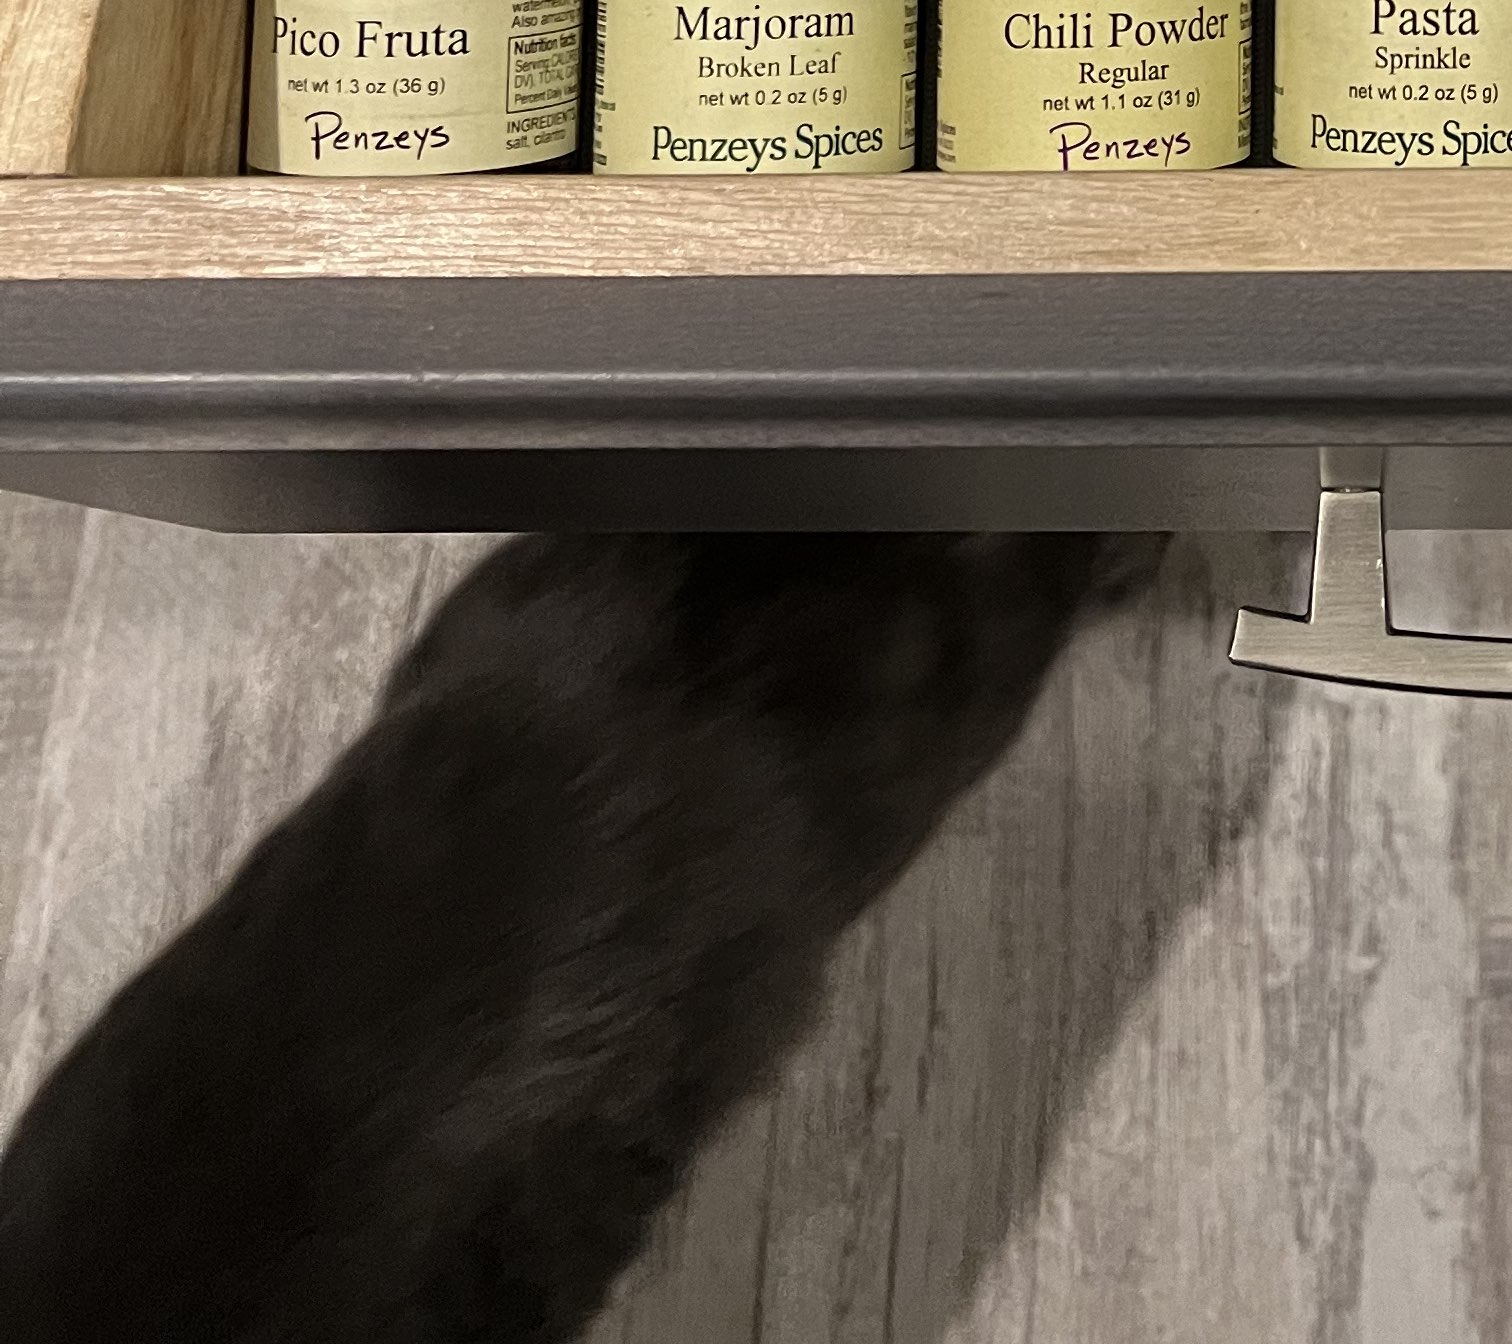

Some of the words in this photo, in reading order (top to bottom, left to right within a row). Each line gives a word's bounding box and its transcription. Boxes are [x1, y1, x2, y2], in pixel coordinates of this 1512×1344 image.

[272, 16, 340, 56] Pico
[355, 20, 470, 59] Fruta
[673, 4, 855, 50] Marjoram
[1004, 12, 1094, 50] Chili
[1107, 6, 1229, 48] Powder
[698, 56, 780, 78] Broken
[789, 52, 841, 76] Leaf
[1078, 60, 1170, 89] Regular
[1374, 46, 1472, 75] Sprinkle
[304, 111, 450, 161] Penzeys
[1049, 121, 1191, 172] Penzeys
